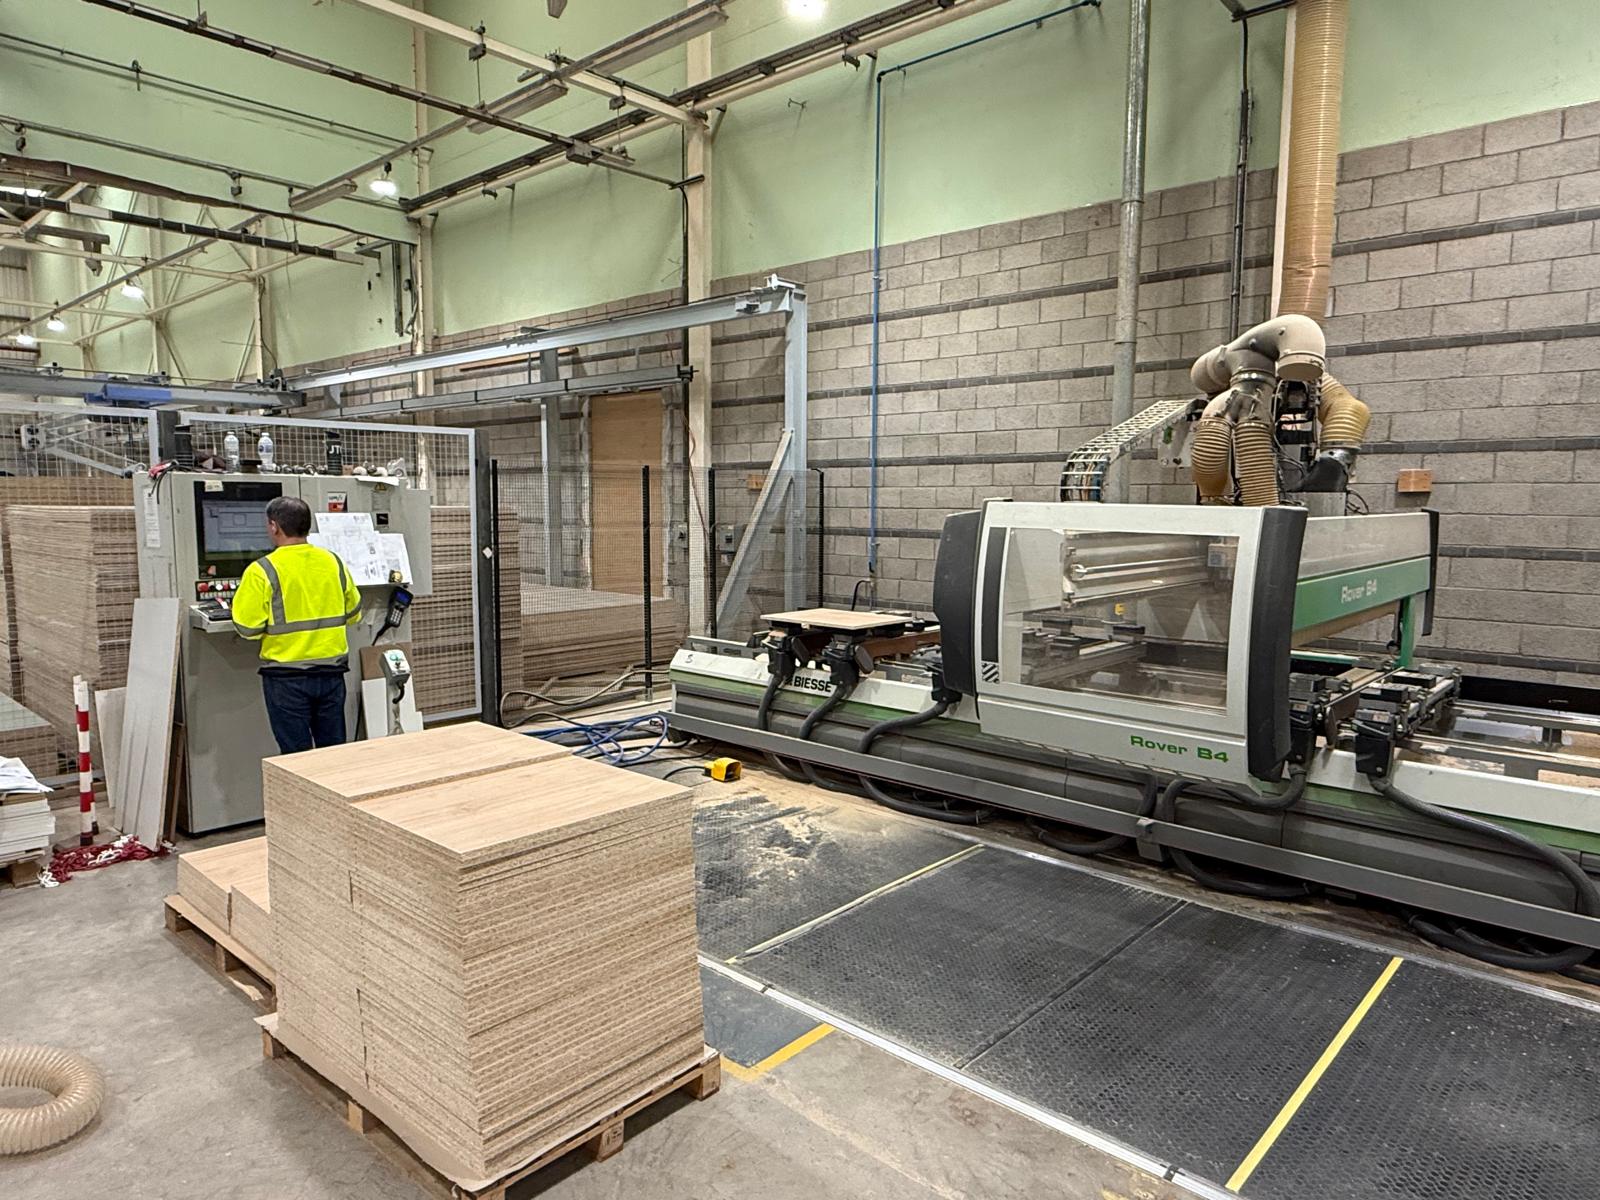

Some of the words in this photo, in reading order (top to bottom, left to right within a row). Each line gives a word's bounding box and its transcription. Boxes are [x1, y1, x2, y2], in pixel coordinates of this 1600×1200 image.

[794, 676, 831, 693] BIESSE
[1130, 735, 1188, 755] Rover
[1197, 746, 1229, 763] B4
